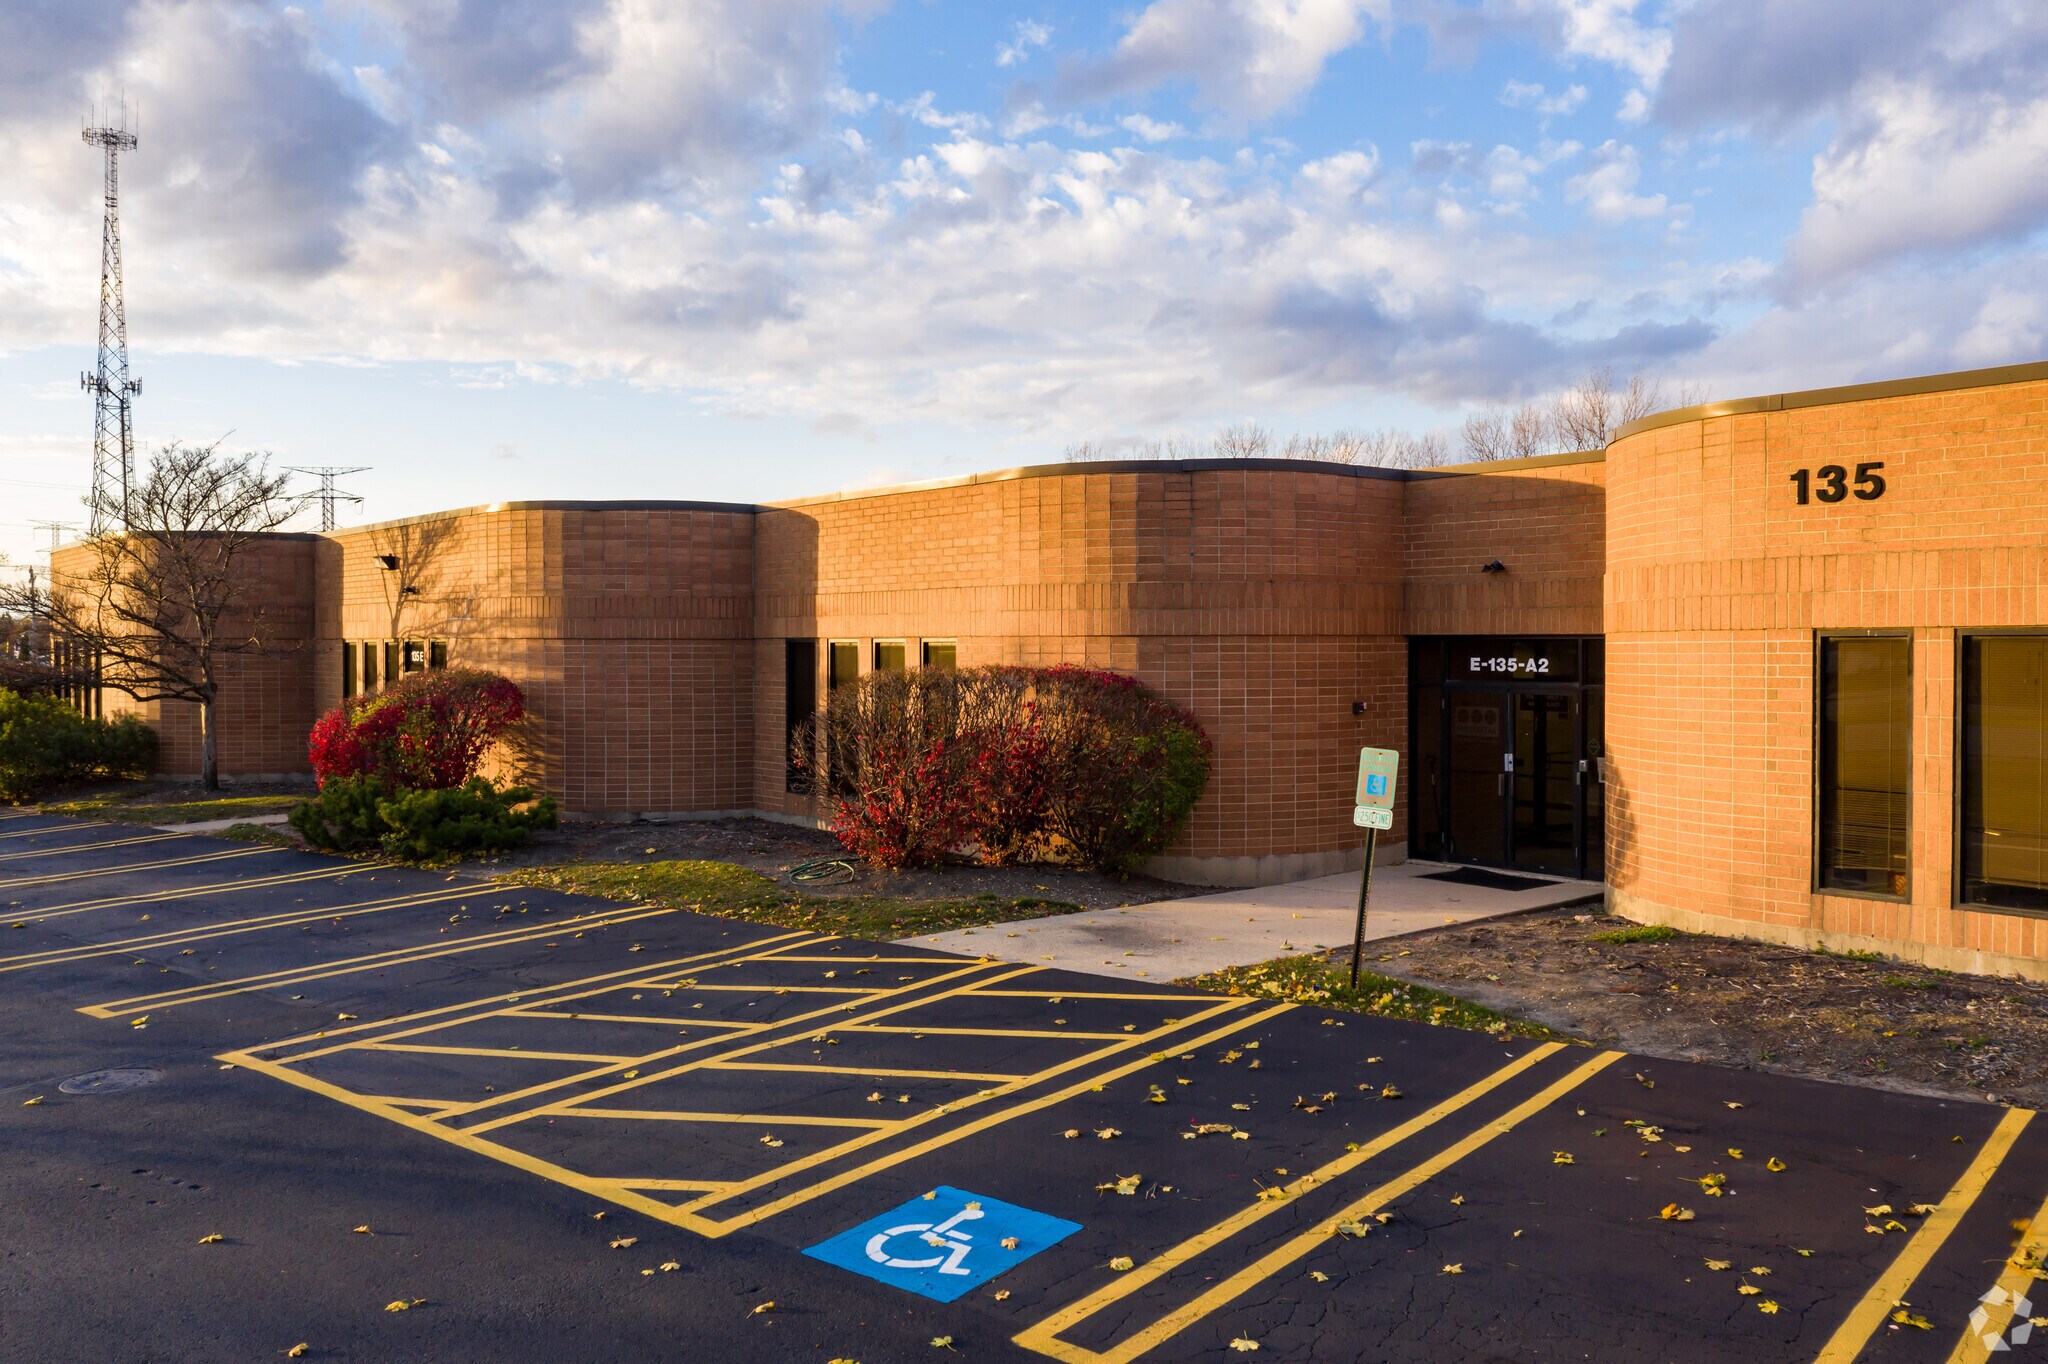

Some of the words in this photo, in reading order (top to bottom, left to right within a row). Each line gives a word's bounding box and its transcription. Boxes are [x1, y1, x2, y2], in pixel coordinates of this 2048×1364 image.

[1790, 461, 1887, 505] 135
[419, 650, 424, 662] E
[1470, 657, 1549, 673] E-135-A2
[1374, 812, 1390, 825] FINE
